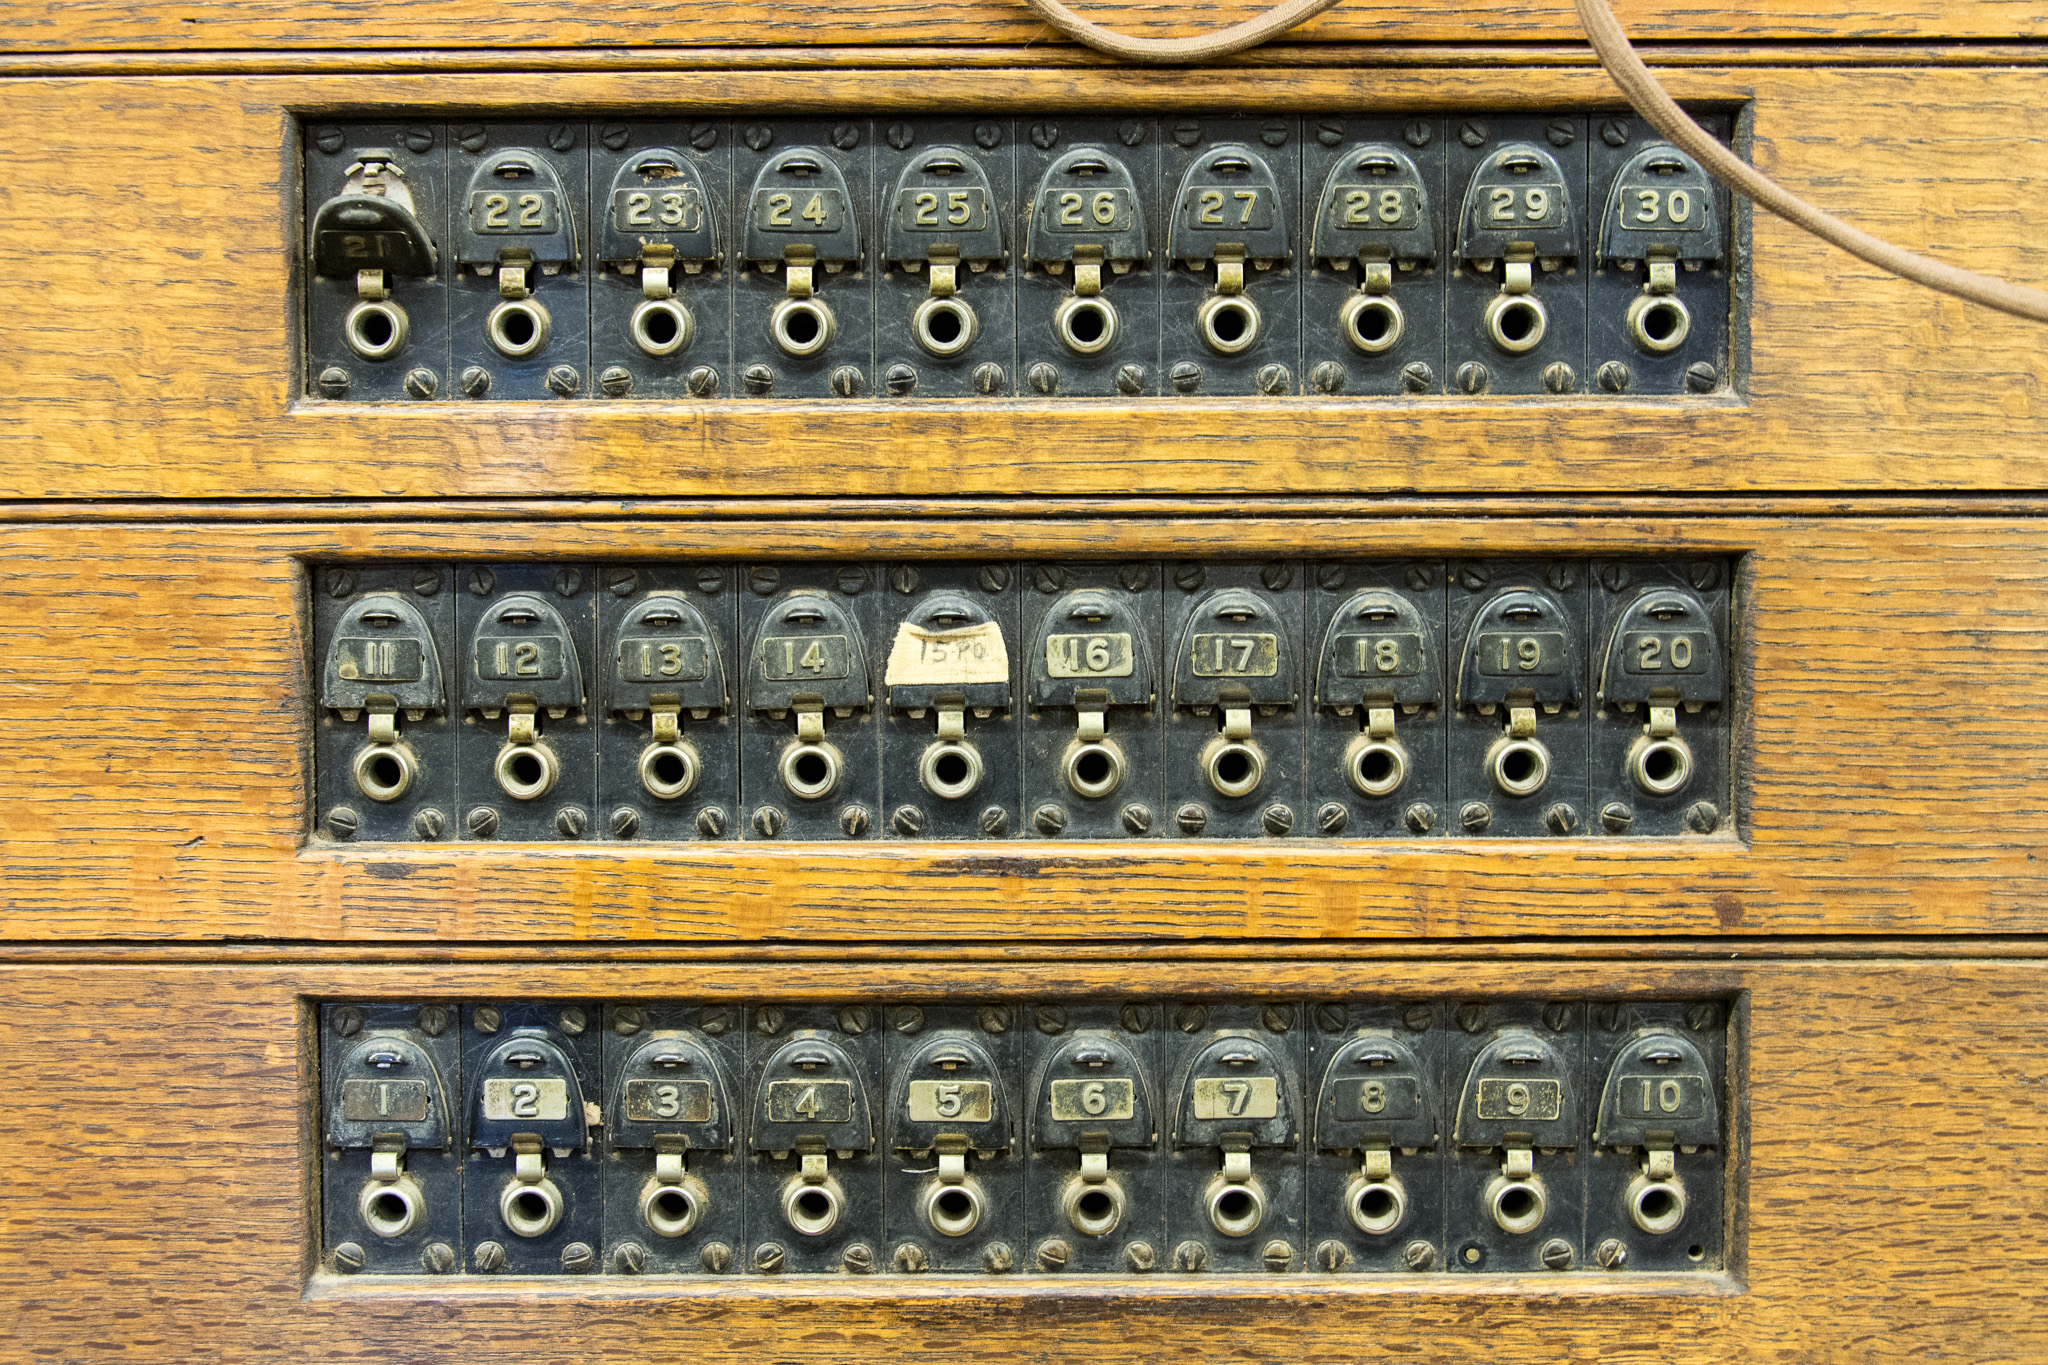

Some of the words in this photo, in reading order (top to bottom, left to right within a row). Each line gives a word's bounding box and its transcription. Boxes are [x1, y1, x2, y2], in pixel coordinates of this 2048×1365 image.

[486, 194, 542, 228] 22
[628, 192, 685, 226] 23
[769, 193, 827, 226] 24
[915, 192, 971, 226] 25
[1060, 192, 1116, 226] 26
[1200, 191, 1257, 224] 27
[1345, 190, 1403, 224] 28
[1492, 189, 1550, 221] 29
[1636, 190, 1691, 223] 30
[343, 235, 388, 259] 21
[366, 643, 390, 675] 11
[495, 643, 539, 675] 12
[641, 644, 682, 677] 13
[782, 641, 825, 675] 14
[1067, 638, 1110, 672] 16
[1214, 638, 1254, 671] 17
[1357, 639, 1399, 672] 18
[1499, 637, 1541, 669] 19
[1639, 636, 1692, 669] 20
[379, 1084, 388, 1116] 1
[513, 1085, 539, 1117] 2
[655, 1085, 680, 1118] 3
[795, 1087, 820, 1119] 4
[936, 1085, 962, 1117] 5
[1083, 1084, 1106, 1115] 6
[1224, 1082, 1251, 1115] 7
[1361, 1081, 1385, 1113] 8
[1507, 1082, 1529, 1115] 9
[1641, 1079, 1682, 1112] 10
